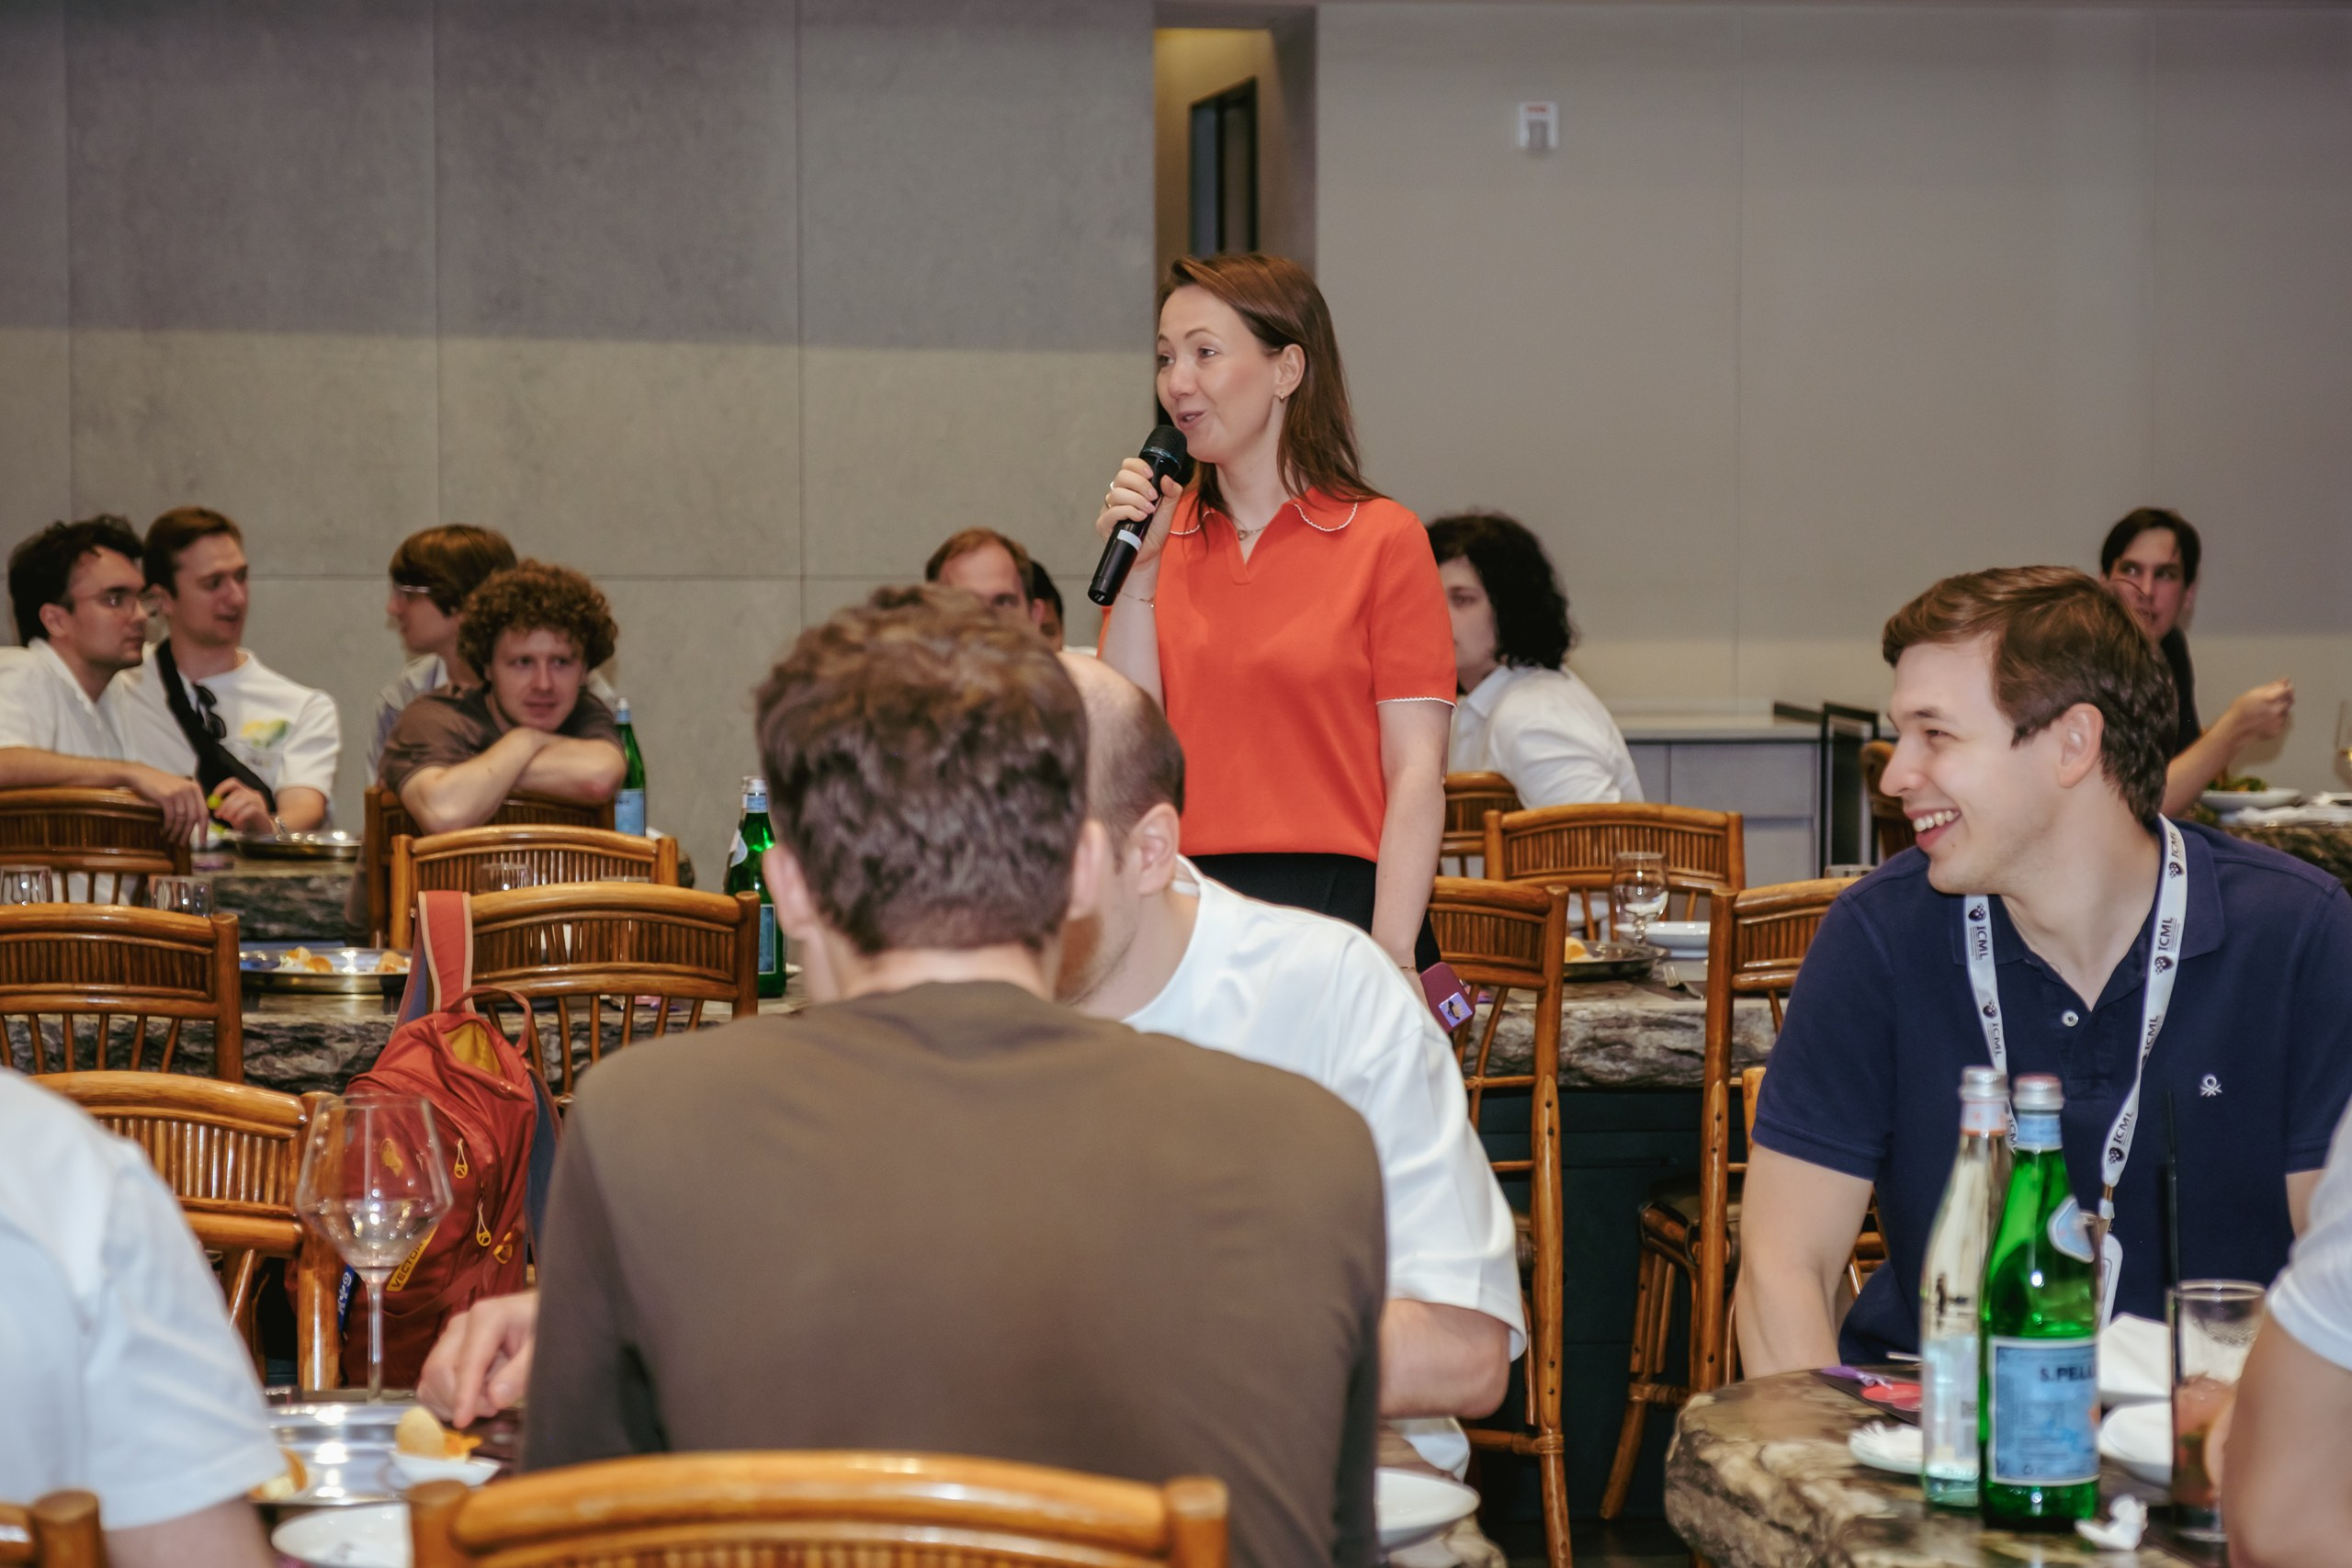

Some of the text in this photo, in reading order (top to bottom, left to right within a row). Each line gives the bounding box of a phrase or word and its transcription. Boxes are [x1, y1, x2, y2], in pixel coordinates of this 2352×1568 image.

[2169, 831, 2179, 858] ICML
[1976, 925, 1989, 956] ICML
[2158, 917, 2173, 952] ICML
[1992, 1022, 2002, 1055] ICML
[2144, 1015, 2159, 1050] ICML
[2113, 1111, 2135, 1145] ICML
